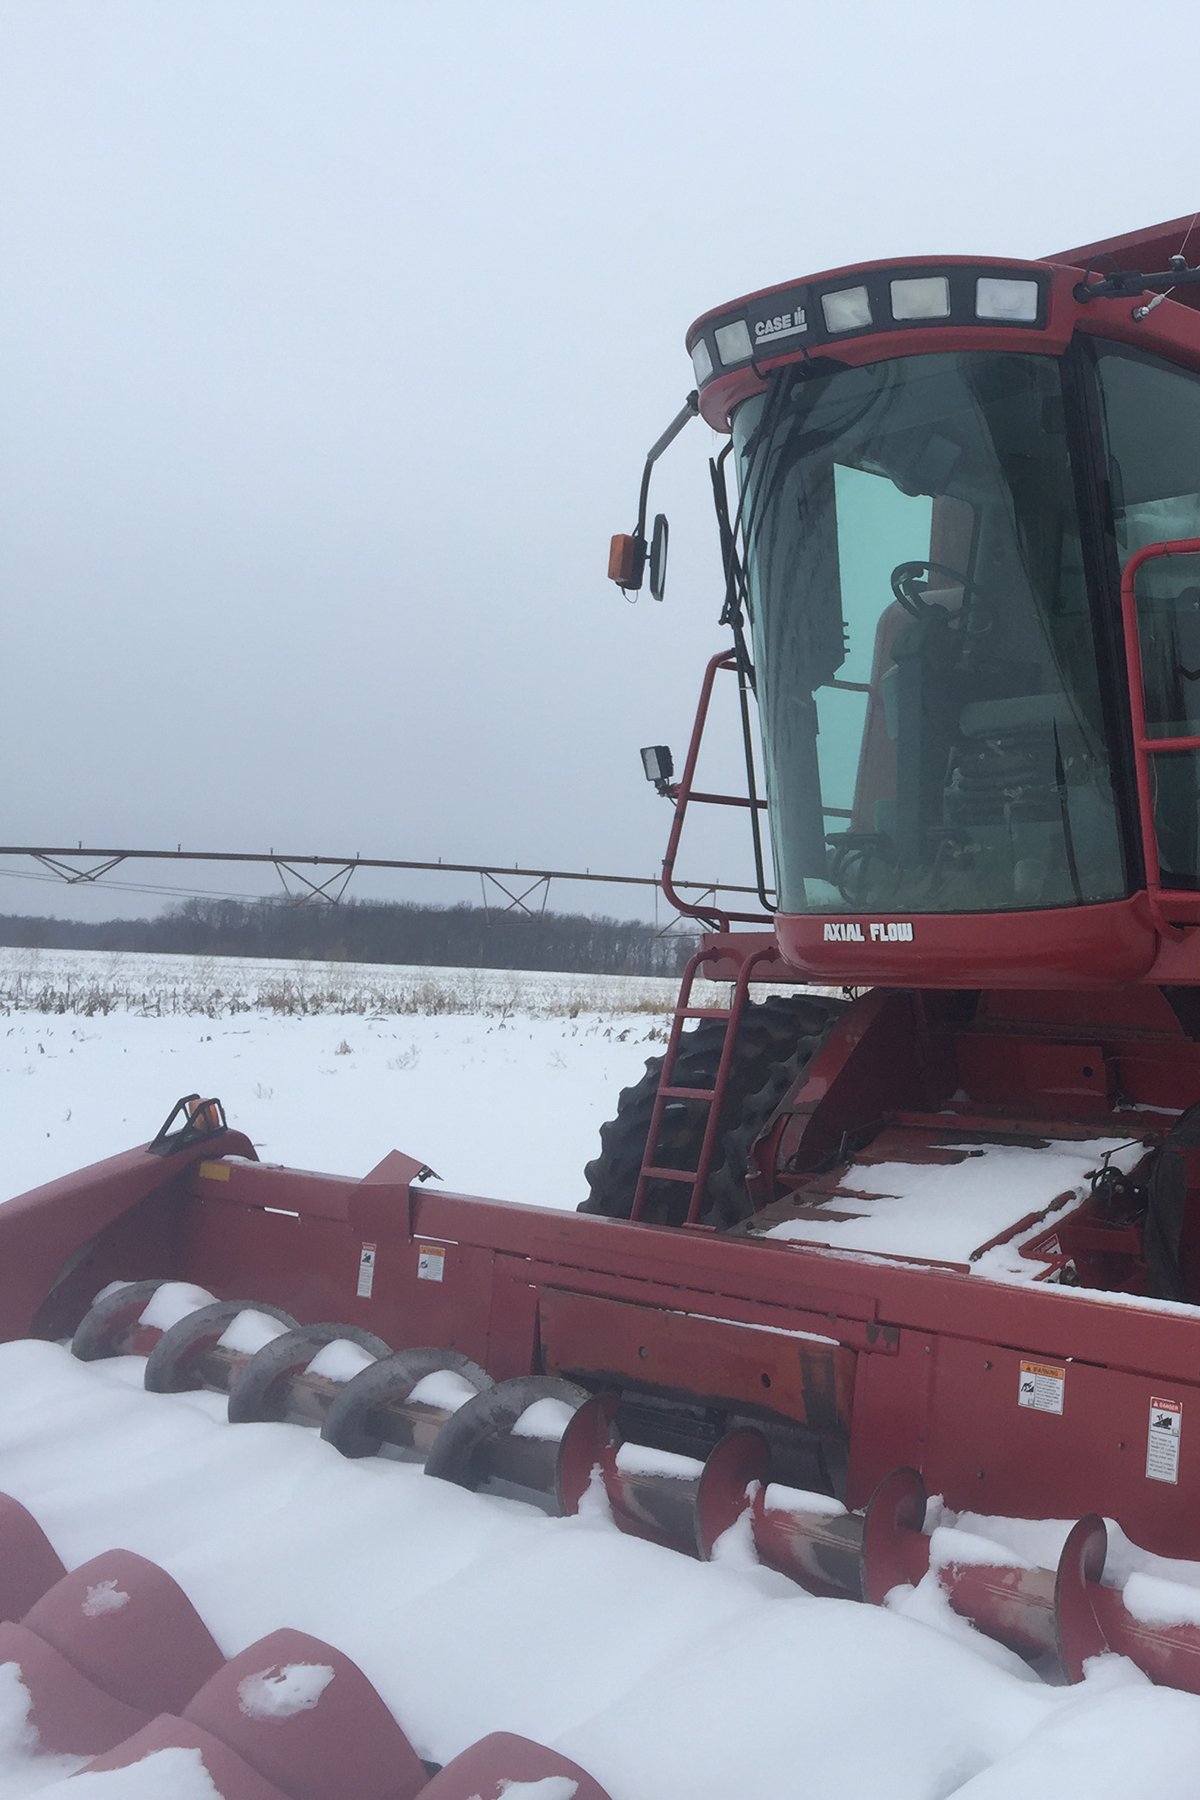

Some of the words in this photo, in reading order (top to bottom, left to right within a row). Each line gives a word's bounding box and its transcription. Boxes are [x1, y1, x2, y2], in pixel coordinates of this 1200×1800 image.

[755, 314, 791, 336] CASE
[824, 923, 865, 942] AXIAL
[869, 923, 914, 942] FLOW
